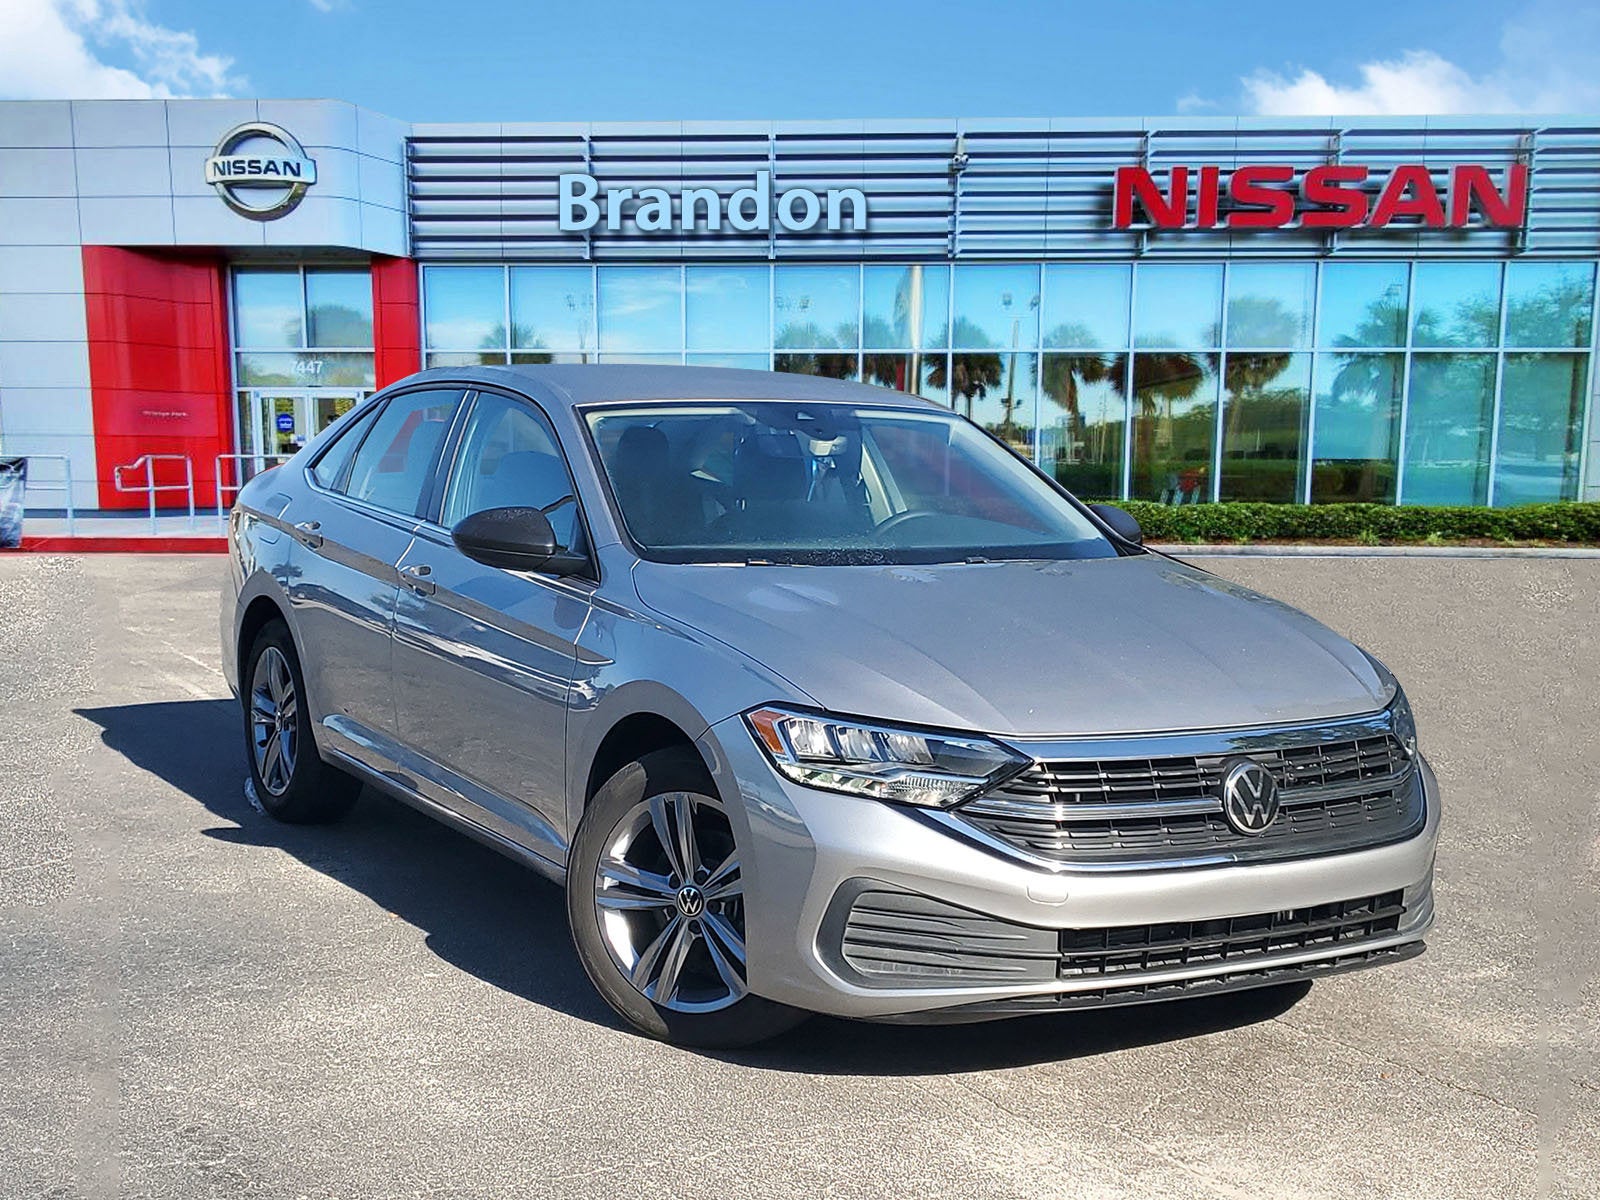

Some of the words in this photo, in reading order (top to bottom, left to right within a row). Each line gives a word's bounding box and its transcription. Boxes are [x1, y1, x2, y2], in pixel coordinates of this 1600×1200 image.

[213, 160, 301, 177] NISSAN
[1112, 164, 1529, 230] NISSAN
[558, 169, 868, 232] Brandon
